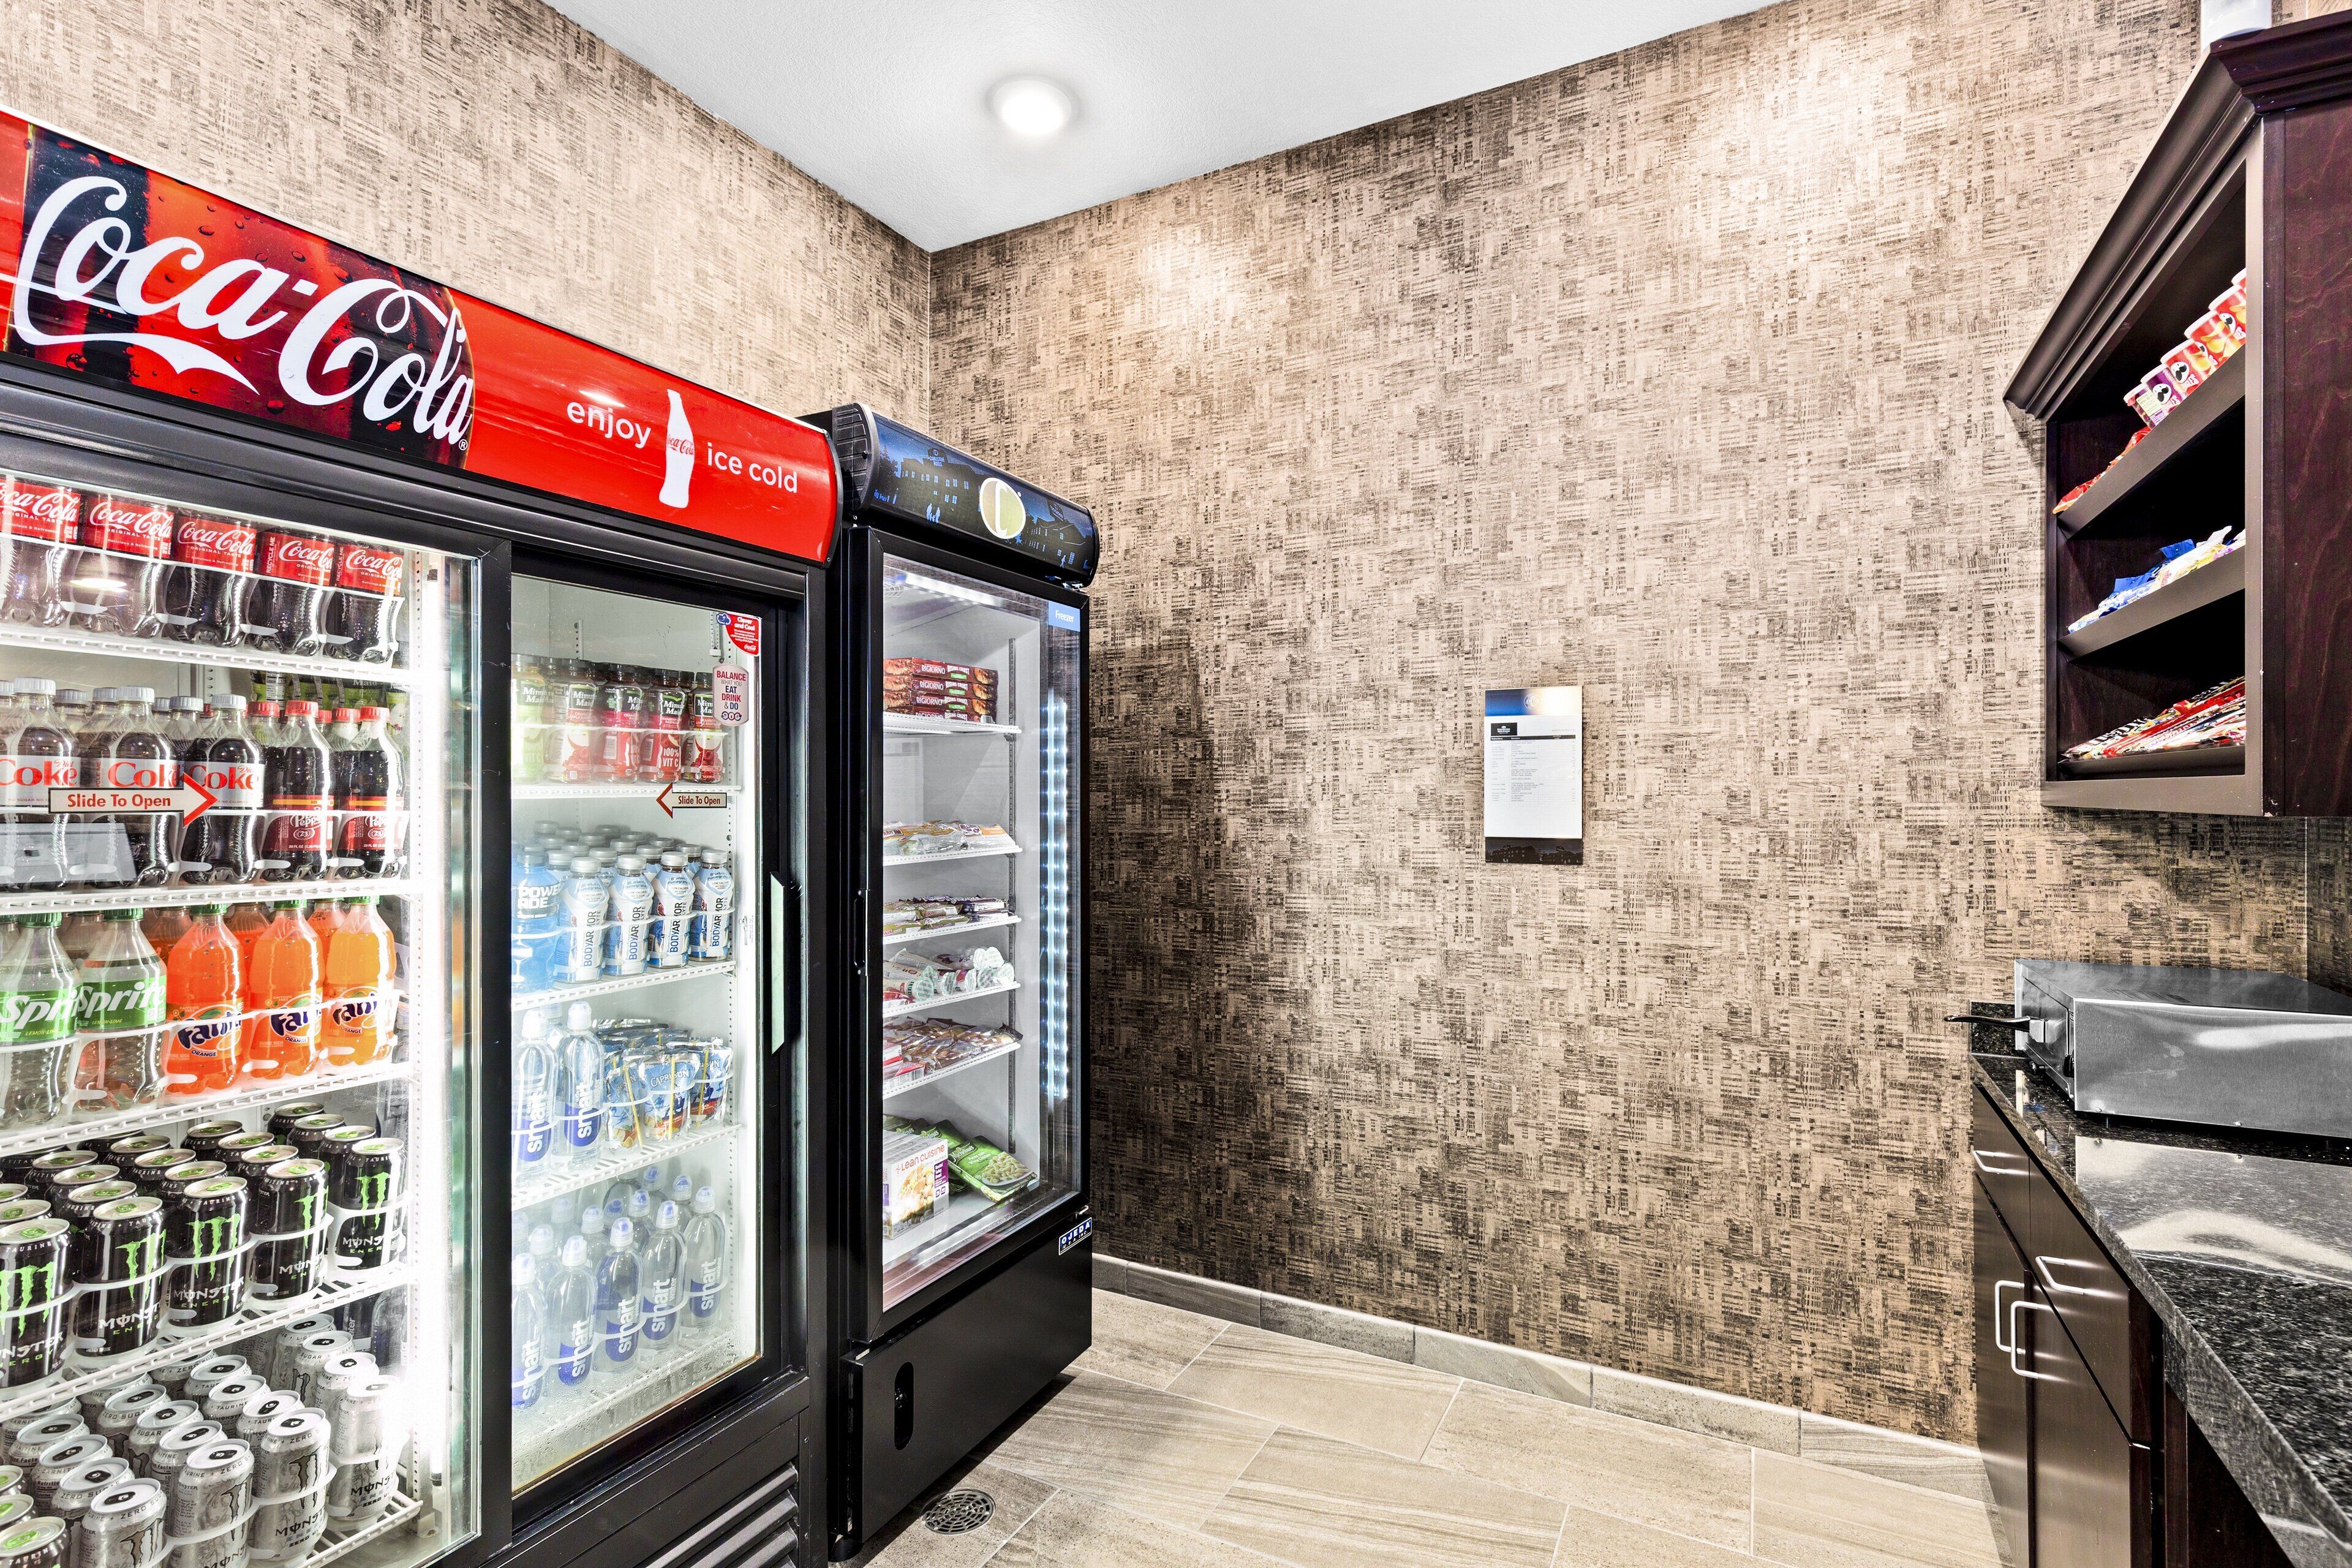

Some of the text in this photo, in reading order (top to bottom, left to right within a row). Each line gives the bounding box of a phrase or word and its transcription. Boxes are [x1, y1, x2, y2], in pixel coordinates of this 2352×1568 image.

[13, 176, 473, 445] Coca-Cola
[567, 401, 652, 449] enjoy
[707, 442, 798, 494] ice cold
[89, 501, 175, 538] Coca-Cola
[177, 521, 257, 556] Coca-Cola
[271, 537, 276, 546] ME
[1055, 610, 1074, 623] Freezer
[717, 670, 747, 681] BALANCE
[725, 685, 737, 694] EAT
[722, 693, 742, 703] DRINK
[663, 748, 679, 757] 100%
[663, 758, 679, 767] VIT C
[67, 793, 171, 810] Slide To Open
[678, 795, 721, 806] Slide To Open
[516, 883, 560, 898] POWE
[198, 1194, 236, 1206] TAURINE
[1061, 1221, 1090, 1245] OJEDA
[6, 1241, 52, 1253] TAURINE
[290, 1432, 313, 1444] ZERO
[220, 1460, 243, 1475] ZERO
[362, 1497, 382, 1508] ZERO
[120, 1505, 147, 1520] ZERO
[288, 1536, 309, 1548] ZERO
[9, 1547, 49, 1566] TAURIN
